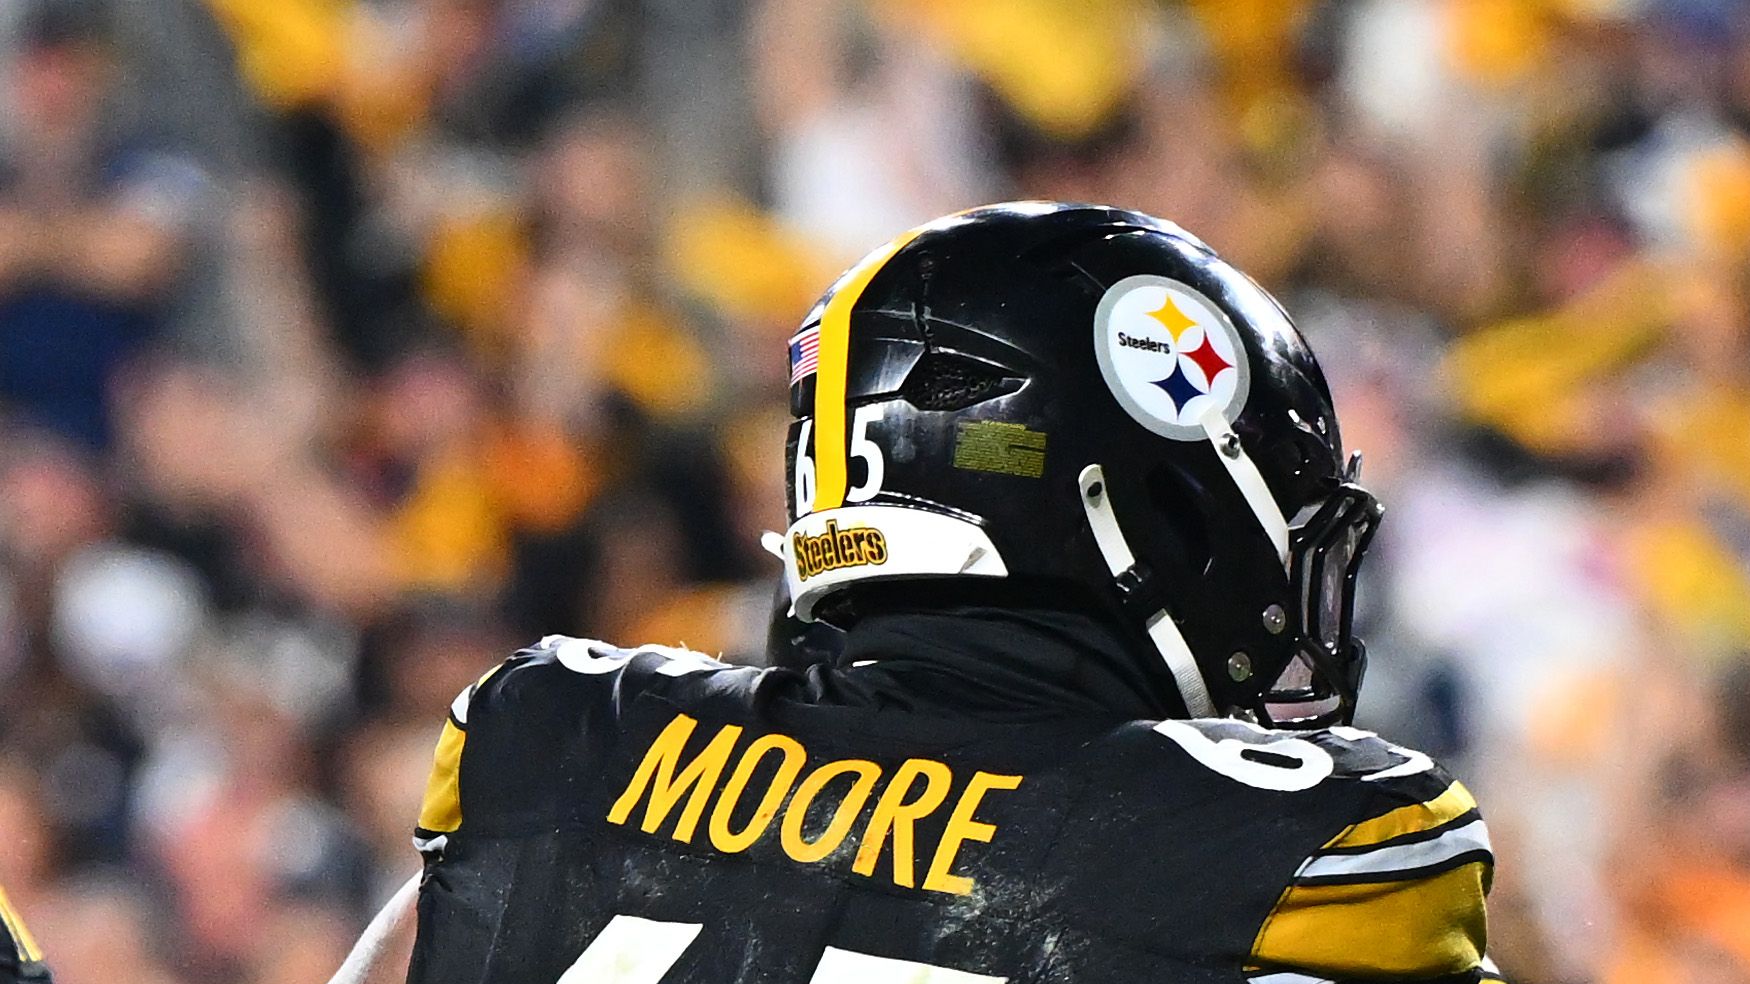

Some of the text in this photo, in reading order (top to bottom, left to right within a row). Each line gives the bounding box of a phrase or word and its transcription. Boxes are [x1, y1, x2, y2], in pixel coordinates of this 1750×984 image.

[1117, 331, 1171, 355] Steelers
[793, 519, 888, 582] Steelers
[606, 713, 1022, 896] MOORE
